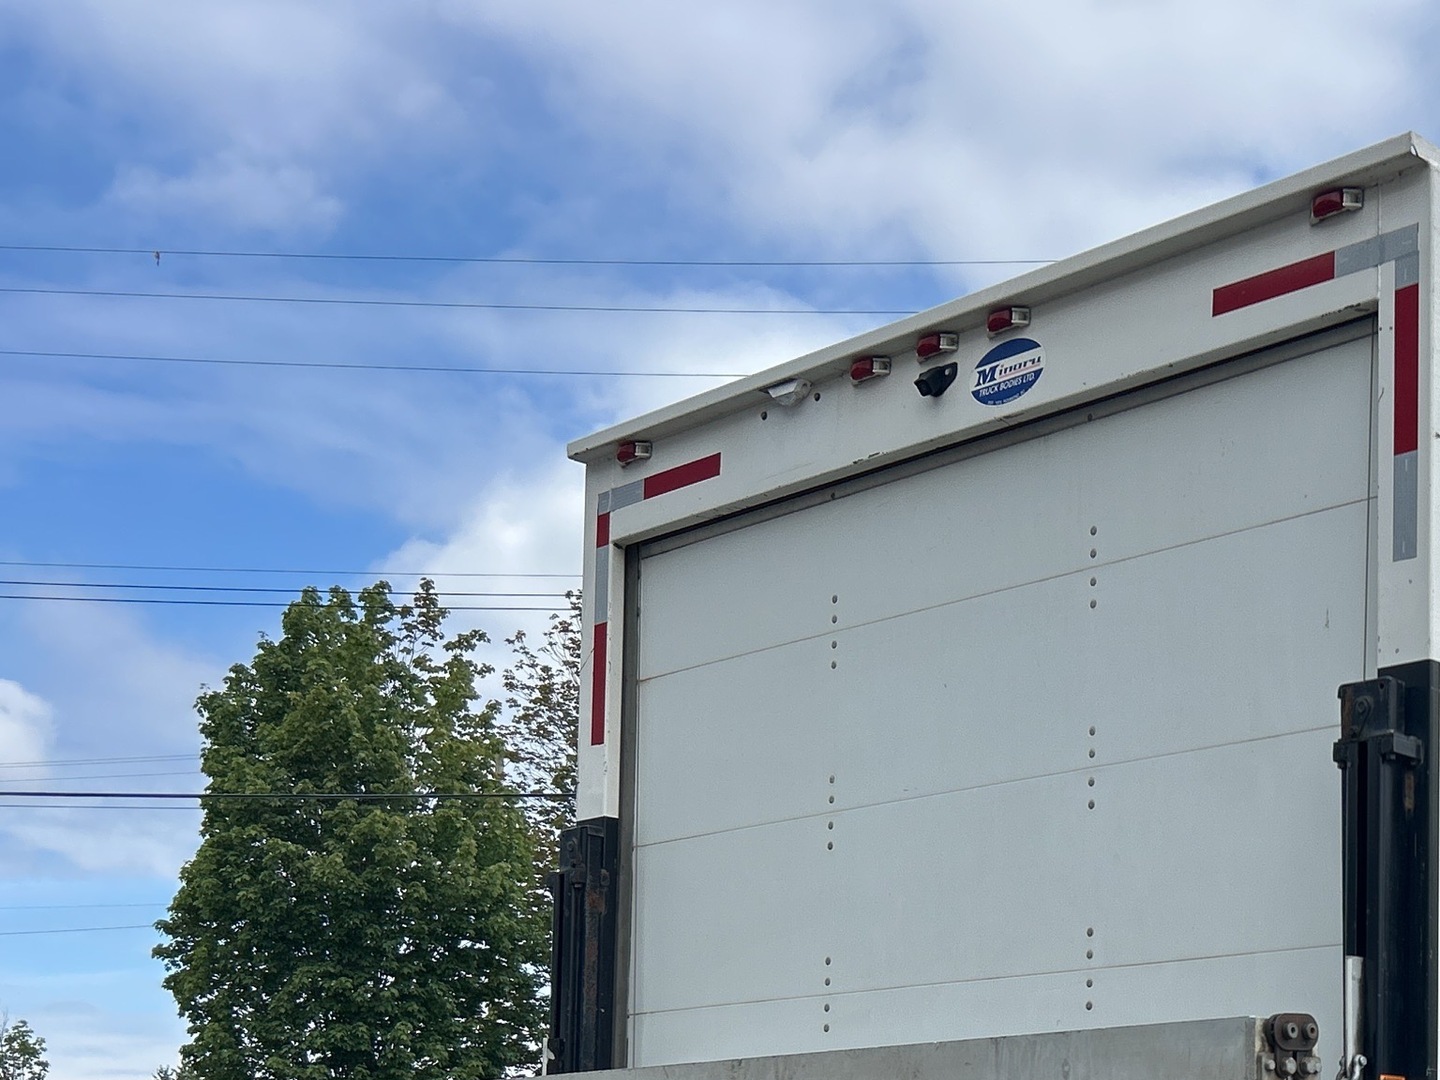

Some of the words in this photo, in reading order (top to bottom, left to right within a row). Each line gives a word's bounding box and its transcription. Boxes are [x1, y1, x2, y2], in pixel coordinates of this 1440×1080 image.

[974, 356, 1042, 388] Minoru
[979, 384, 999, 397] TRUCK
[999, 378, 1022, 391] BODIES
